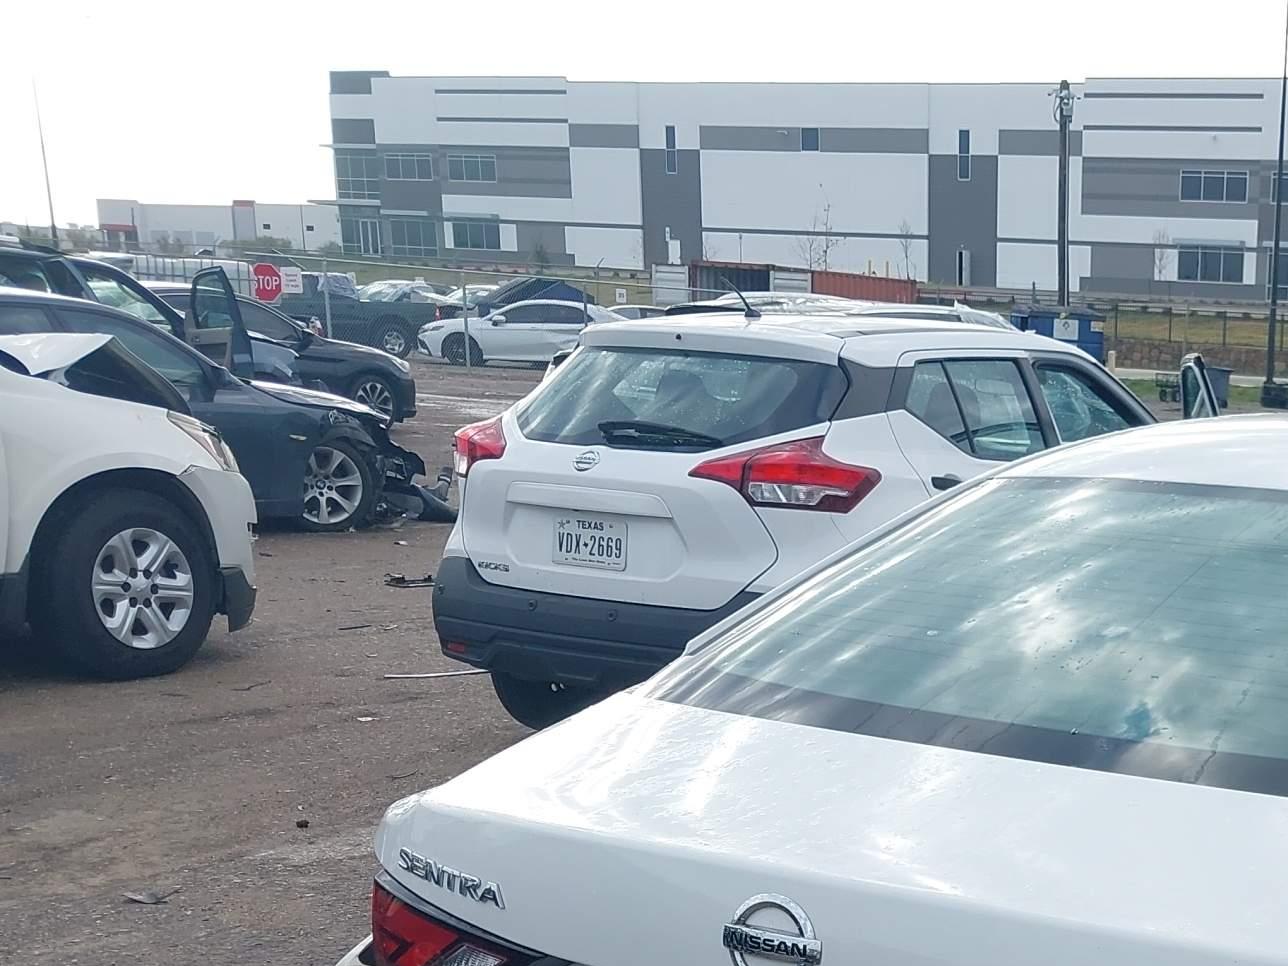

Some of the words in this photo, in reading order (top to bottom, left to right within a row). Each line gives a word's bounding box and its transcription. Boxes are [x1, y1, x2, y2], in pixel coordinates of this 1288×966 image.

[576, 520, 604, 531] TEXAS
[398, 847, 505, 909] SENTRA
[729, 926, 808, 958] NISSAN
